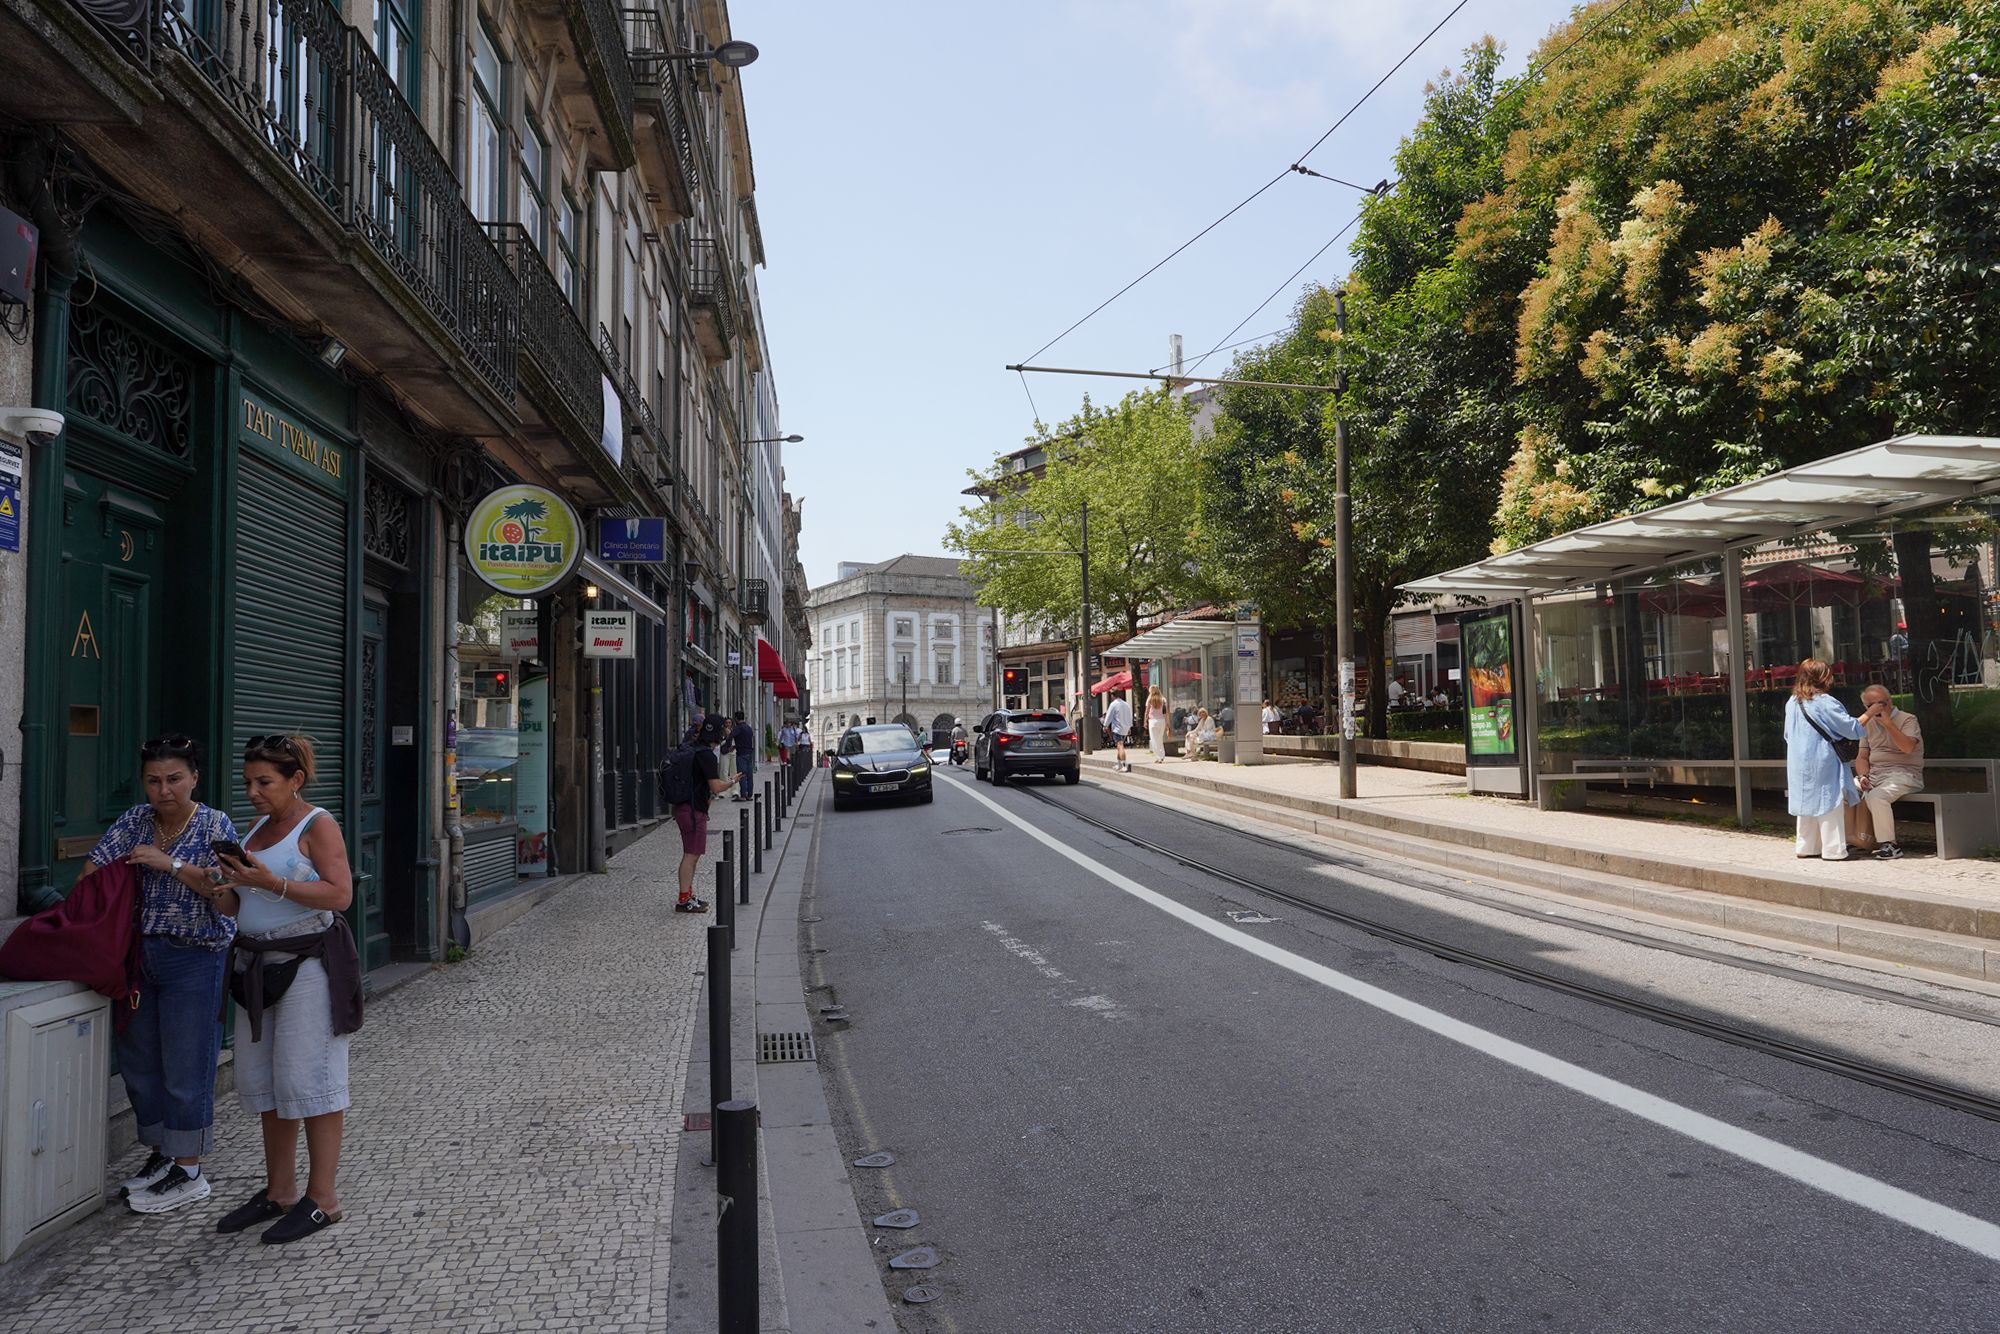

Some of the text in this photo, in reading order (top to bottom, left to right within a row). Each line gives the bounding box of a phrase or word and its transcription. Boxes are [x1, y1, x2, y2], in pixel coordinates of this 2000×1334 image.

[242, 398, 341, 479] TAT TVAM ASI
[480, 543, 562, 563] itaipu
[591, 616, 627, 625] itaipu
[593, 637, 624, 647] Buondi
